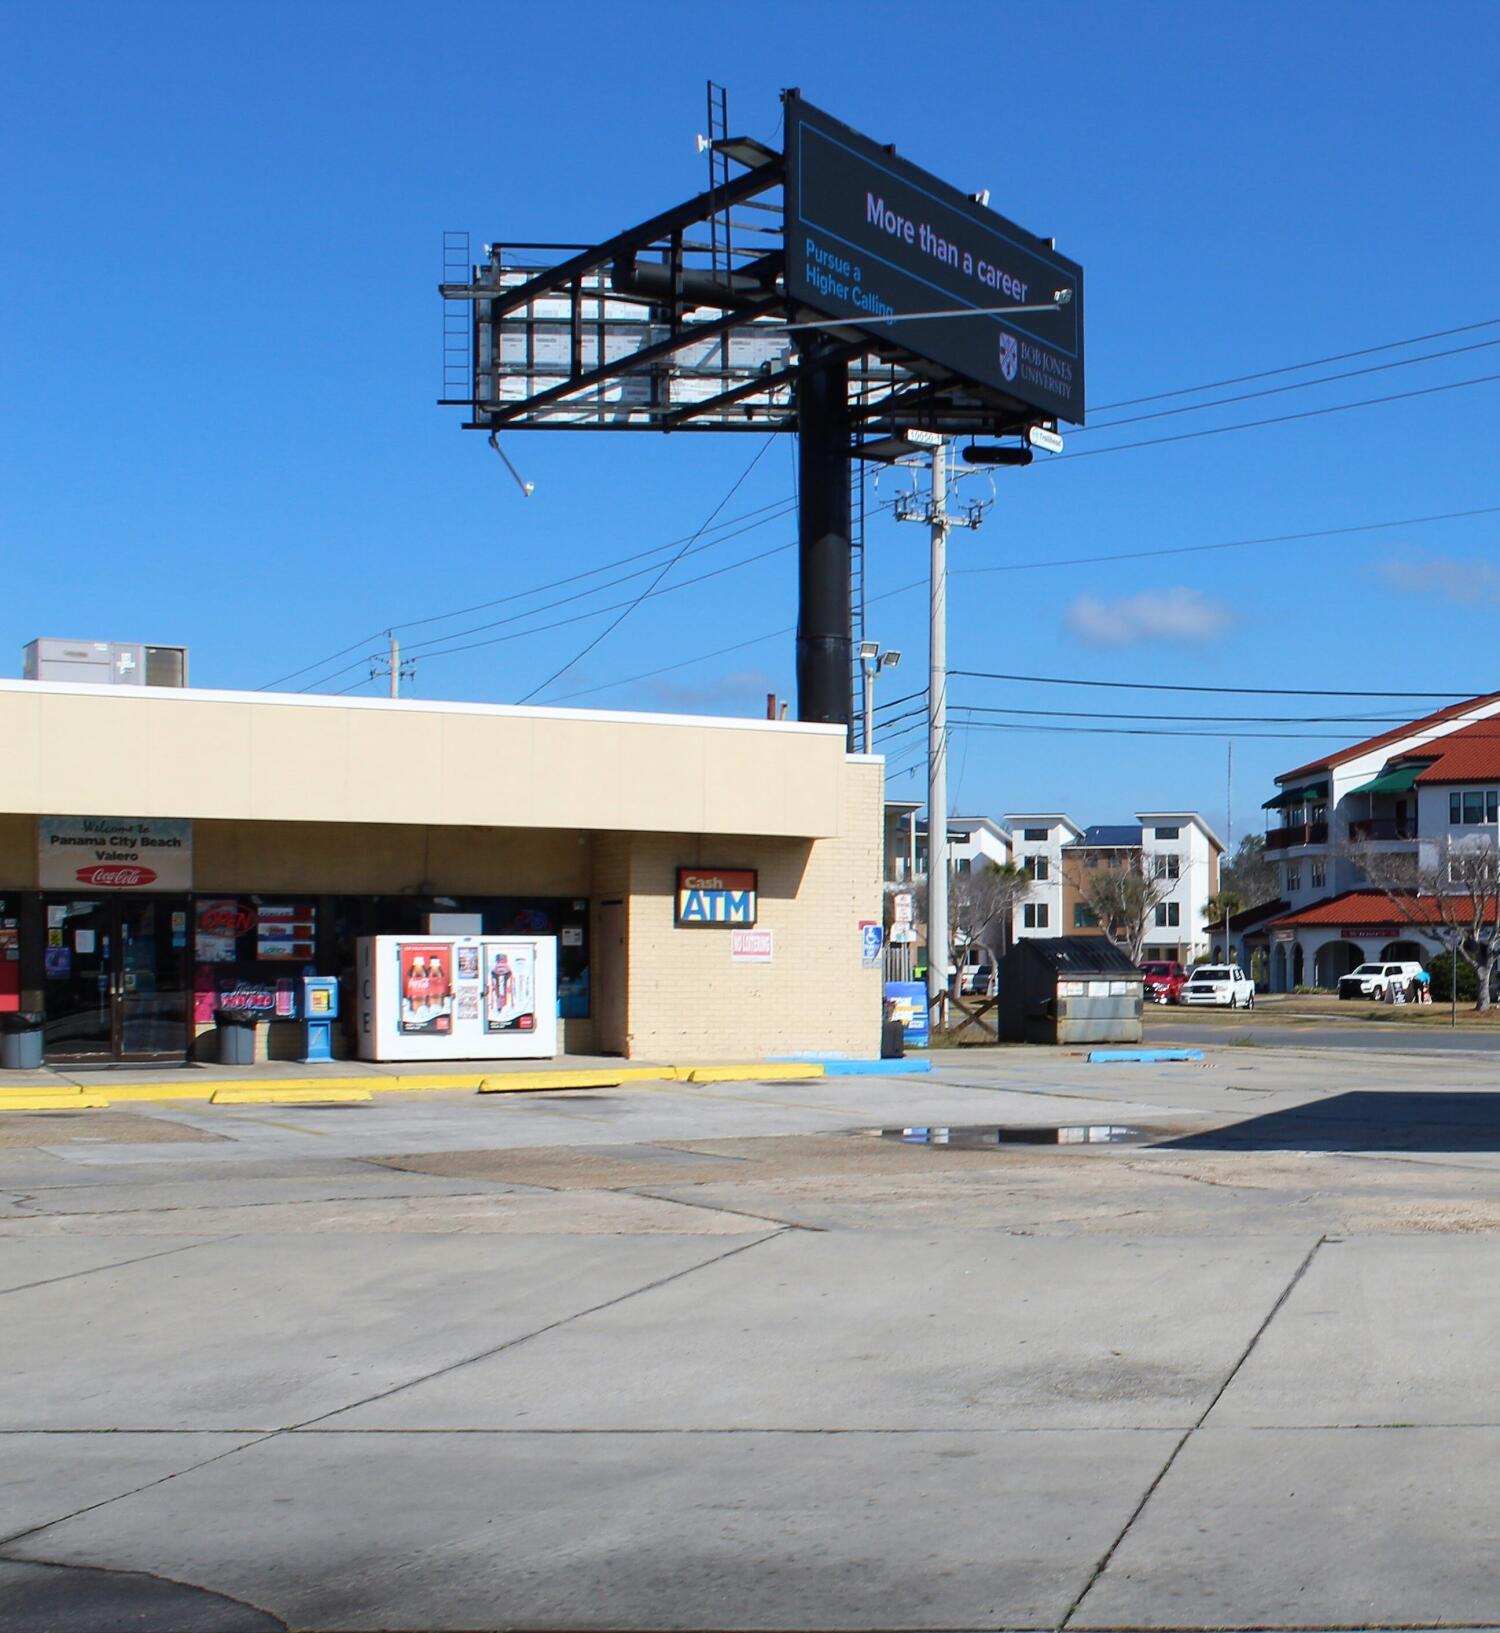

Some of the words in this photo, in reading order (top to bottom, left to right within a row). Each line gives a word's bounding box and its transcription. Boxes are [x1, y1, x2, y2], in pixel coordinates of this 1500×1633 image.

[806, 237, 850, 277] Pursue
[853, 265, 862, 282] a
[866, 192, 914, 244] More
[919, 223, 959, 268] than
[963, 252, 973, 275] a
[977, 260, 1028, 303] career
[806, 263, 849, 301] Higher
[1042, 352, 1073, 381] JONES
[1020, 363, 1073, 400] UNIVERSITY
[83, 819, 132, 834] Welcome
[50, 835, 106, 847] Panama
[109, 836, 138, 848] City
[140, 837, 182, 848] Beach
[95, 850, 139, 861] Valero
[91, 867, 141, 885] Coca-Cola
[685, 876, 723, 889] Cash
[681, 889, 751, 921] ATM
[199, 910, 252, 931] OPEN
[363, 945, 371, 1034] ICE
